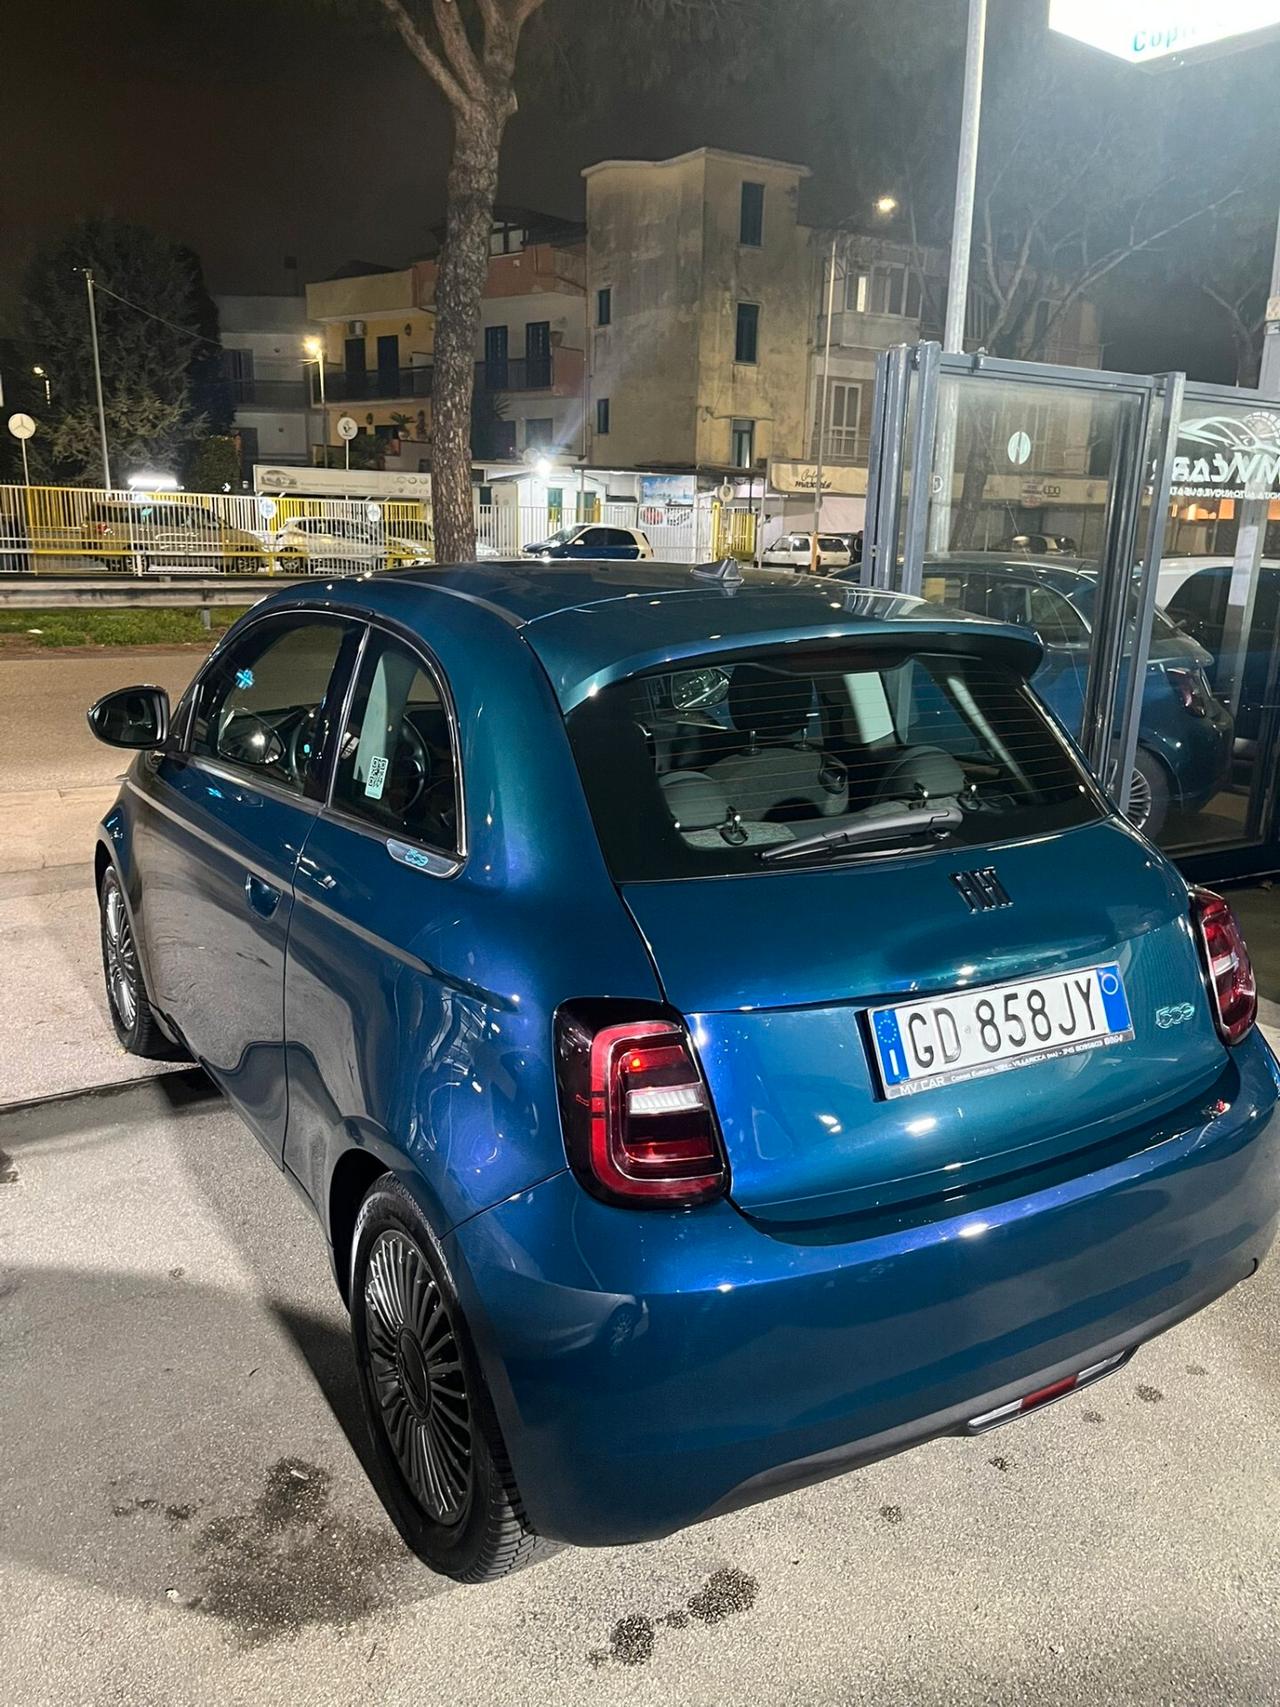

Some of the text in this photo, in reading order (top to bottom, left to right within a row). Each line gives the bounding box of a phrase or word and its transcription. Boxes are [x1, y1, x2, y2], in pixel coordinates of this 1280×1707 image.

[907, 977, 1098, 1069] GD 858 JY
[920, 1076, 945, 1090] CAR
